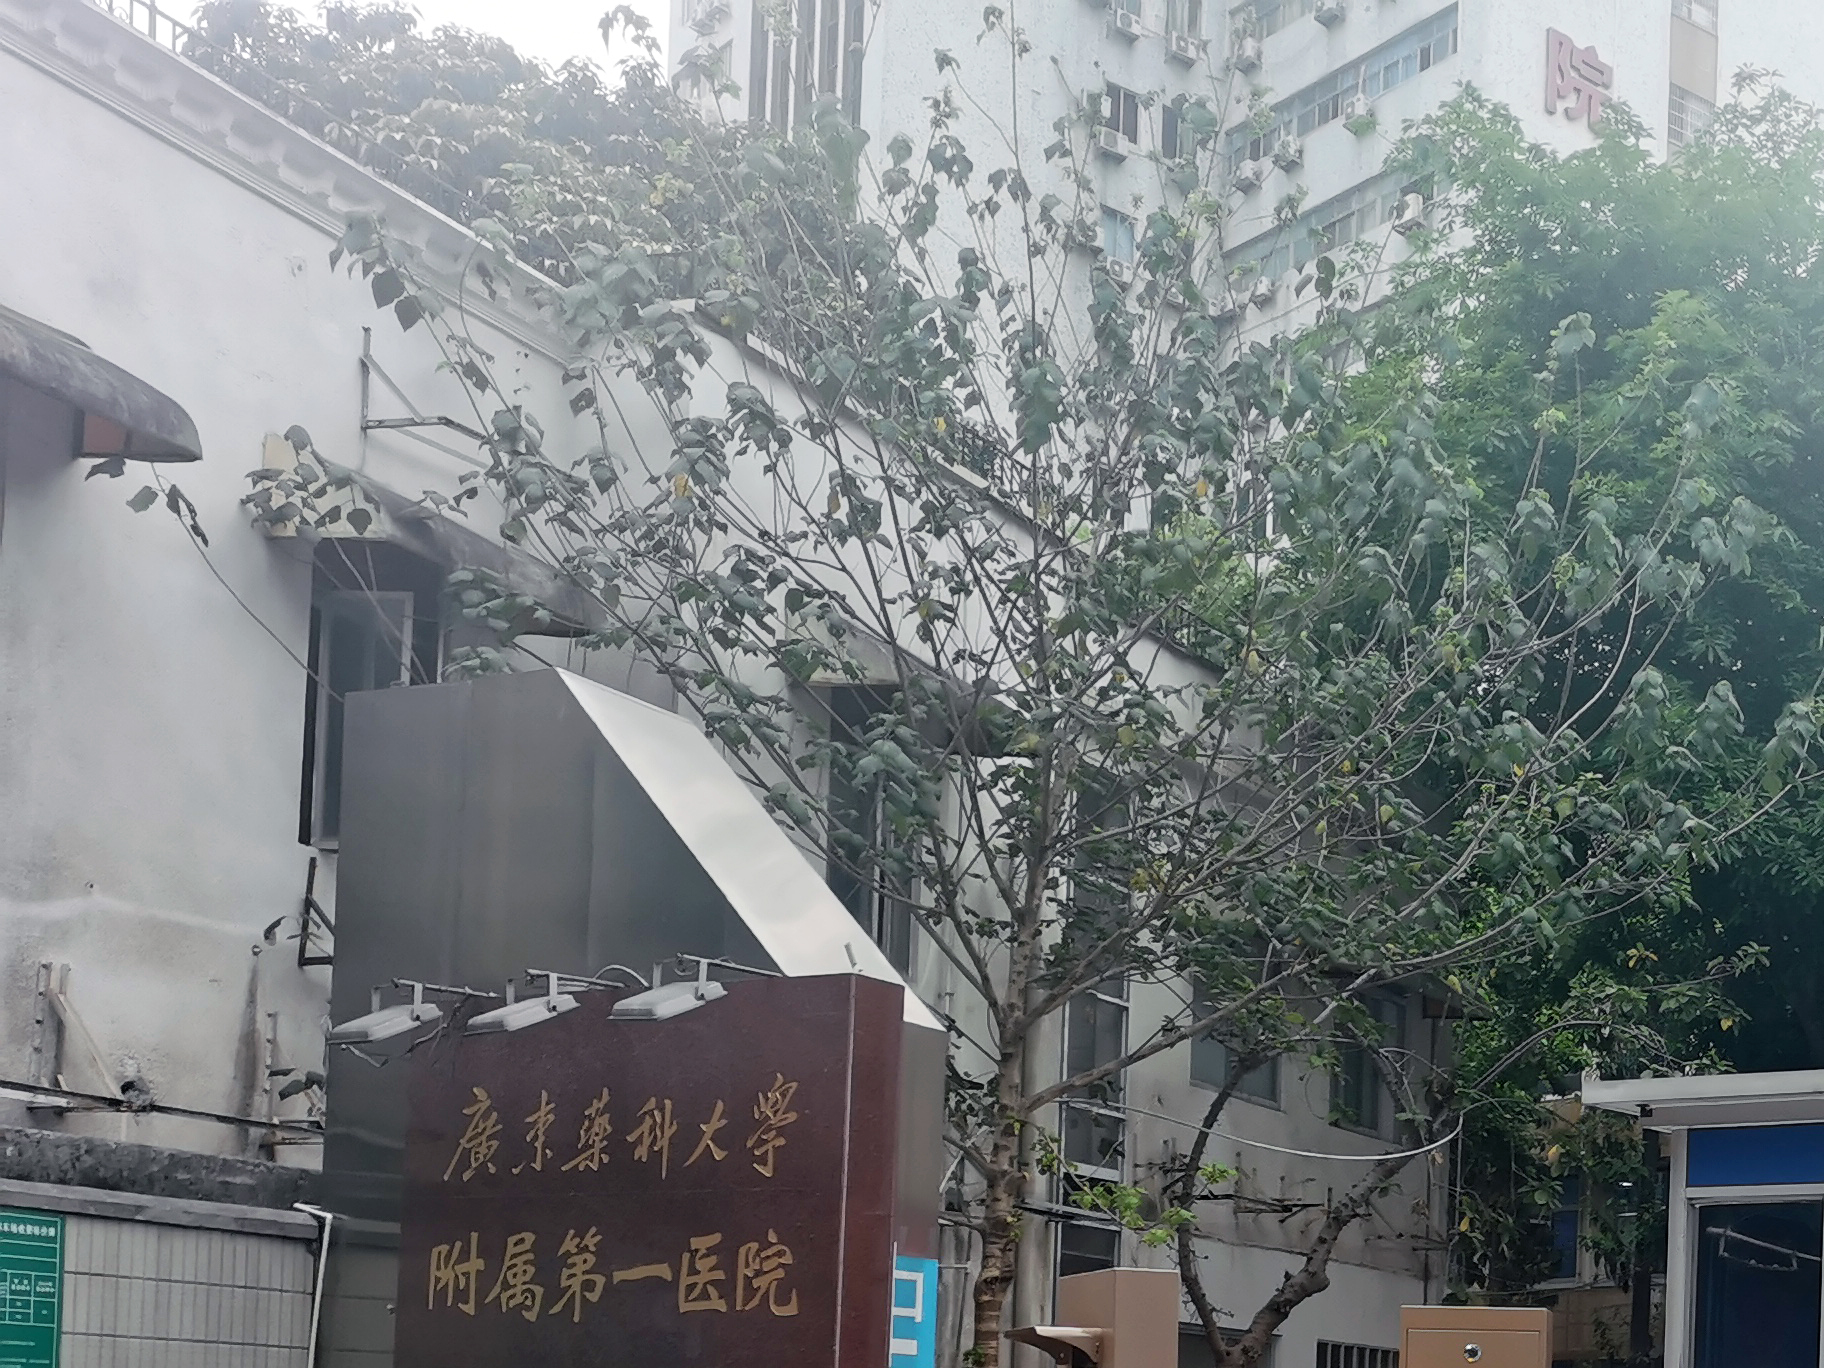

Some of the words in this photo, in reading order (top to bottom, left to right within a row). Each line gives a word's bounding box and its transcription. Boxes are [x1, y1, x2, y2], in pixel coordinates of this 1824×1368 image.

[1545, 26, 1614, 138] 院
[427, 1226, 800, 1323] 附属第一医院
